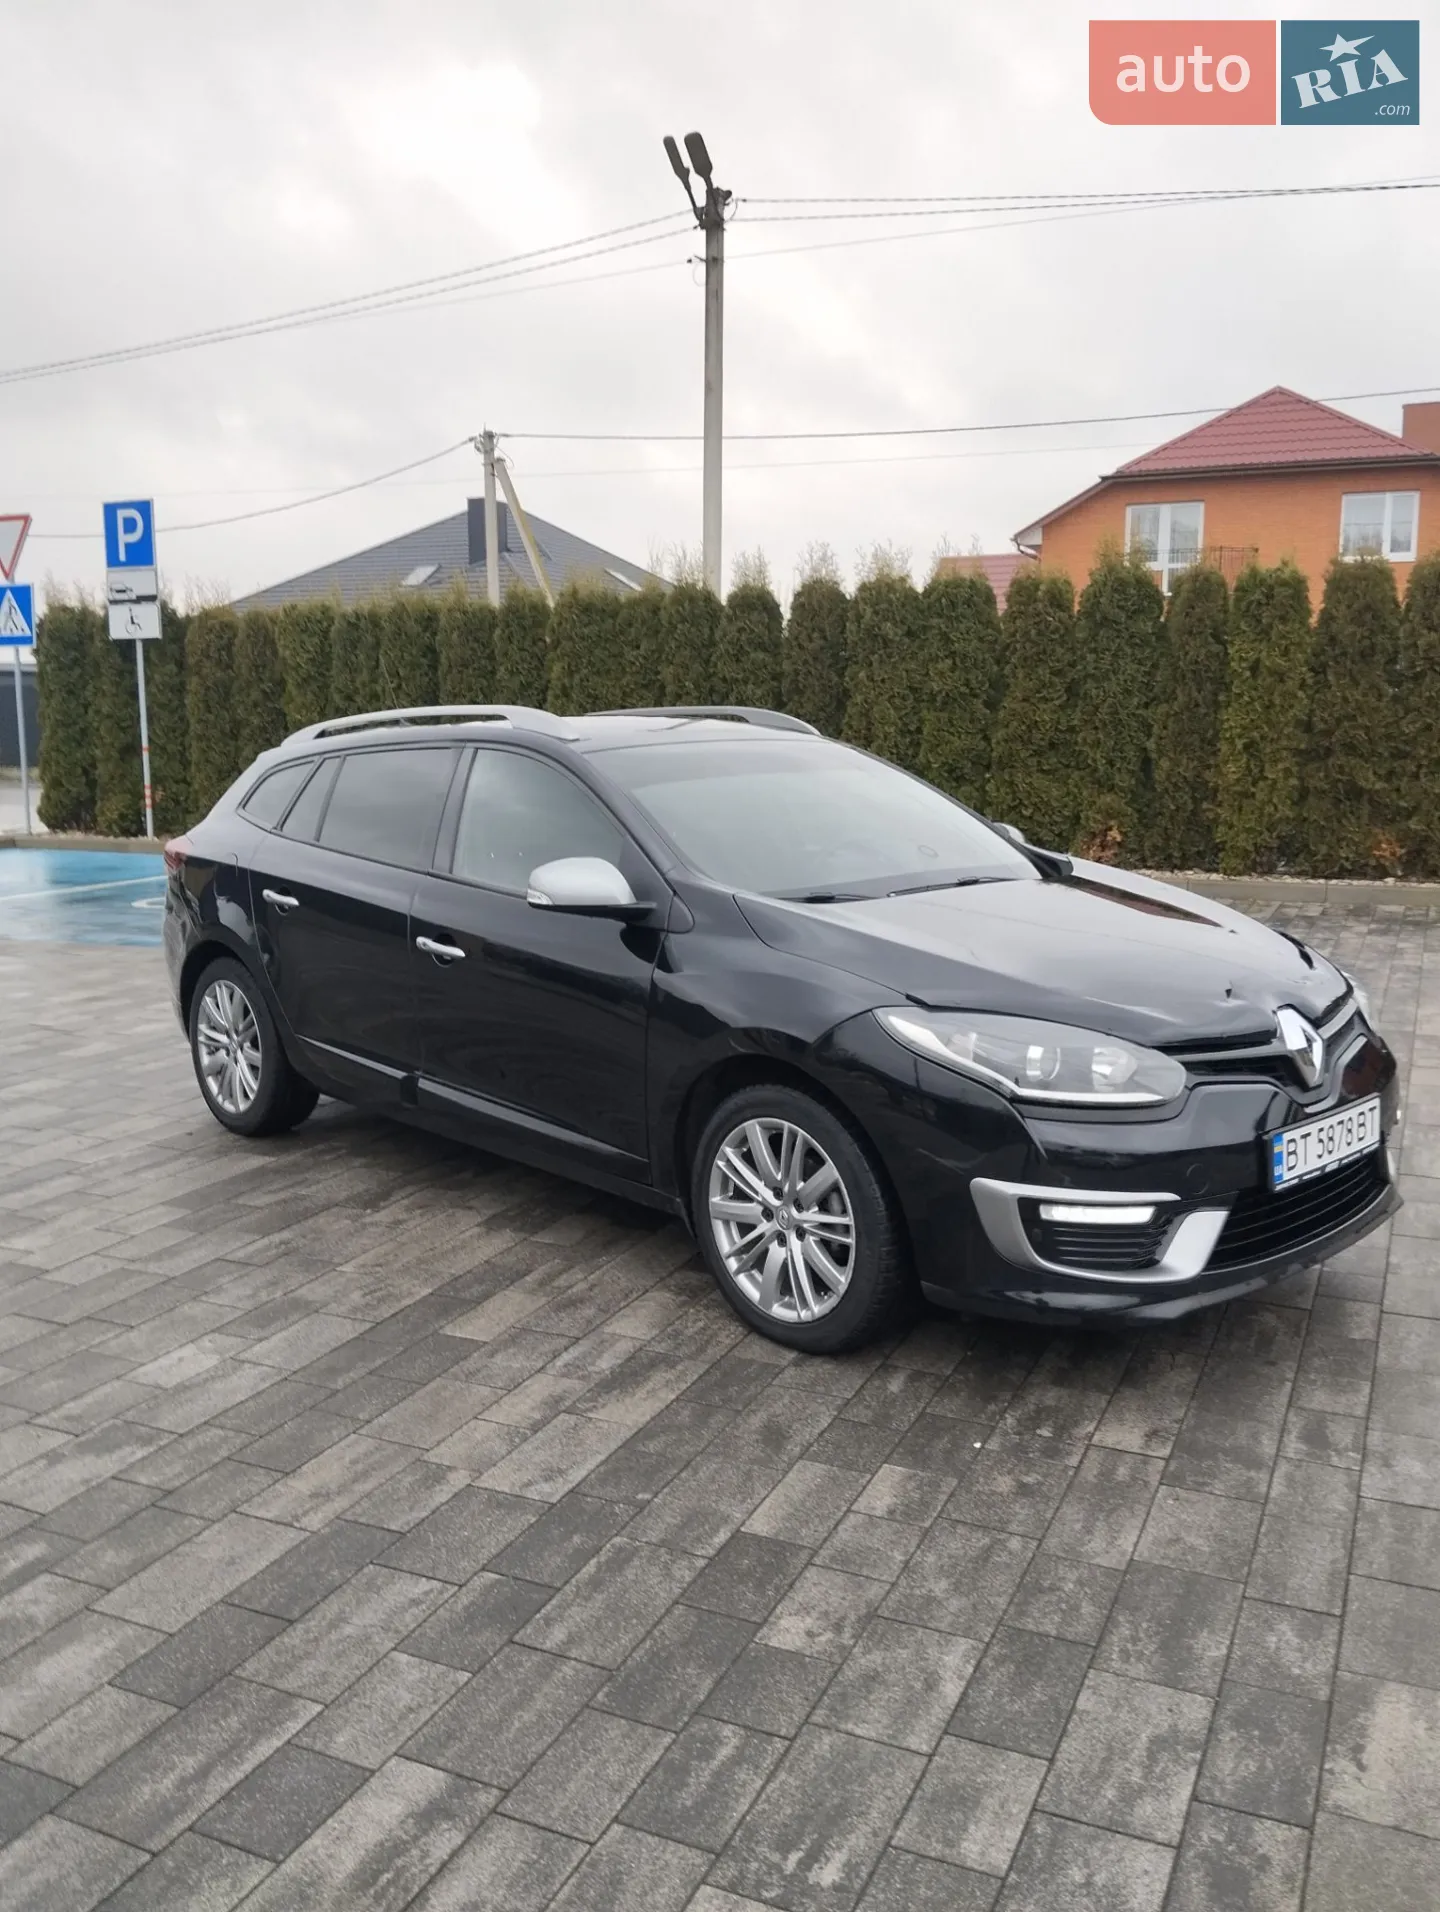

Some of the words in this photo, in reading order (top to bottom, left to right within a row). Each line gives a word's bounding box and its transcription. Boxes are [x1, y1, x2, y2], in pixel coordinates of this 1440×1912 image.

[116, 508, 144, 562] P
[1286, 1132, 1312, 1172] BT
[1316, 1116, 1354, 1160] 5878
[1356, 1105, 1377, 1142] BT
